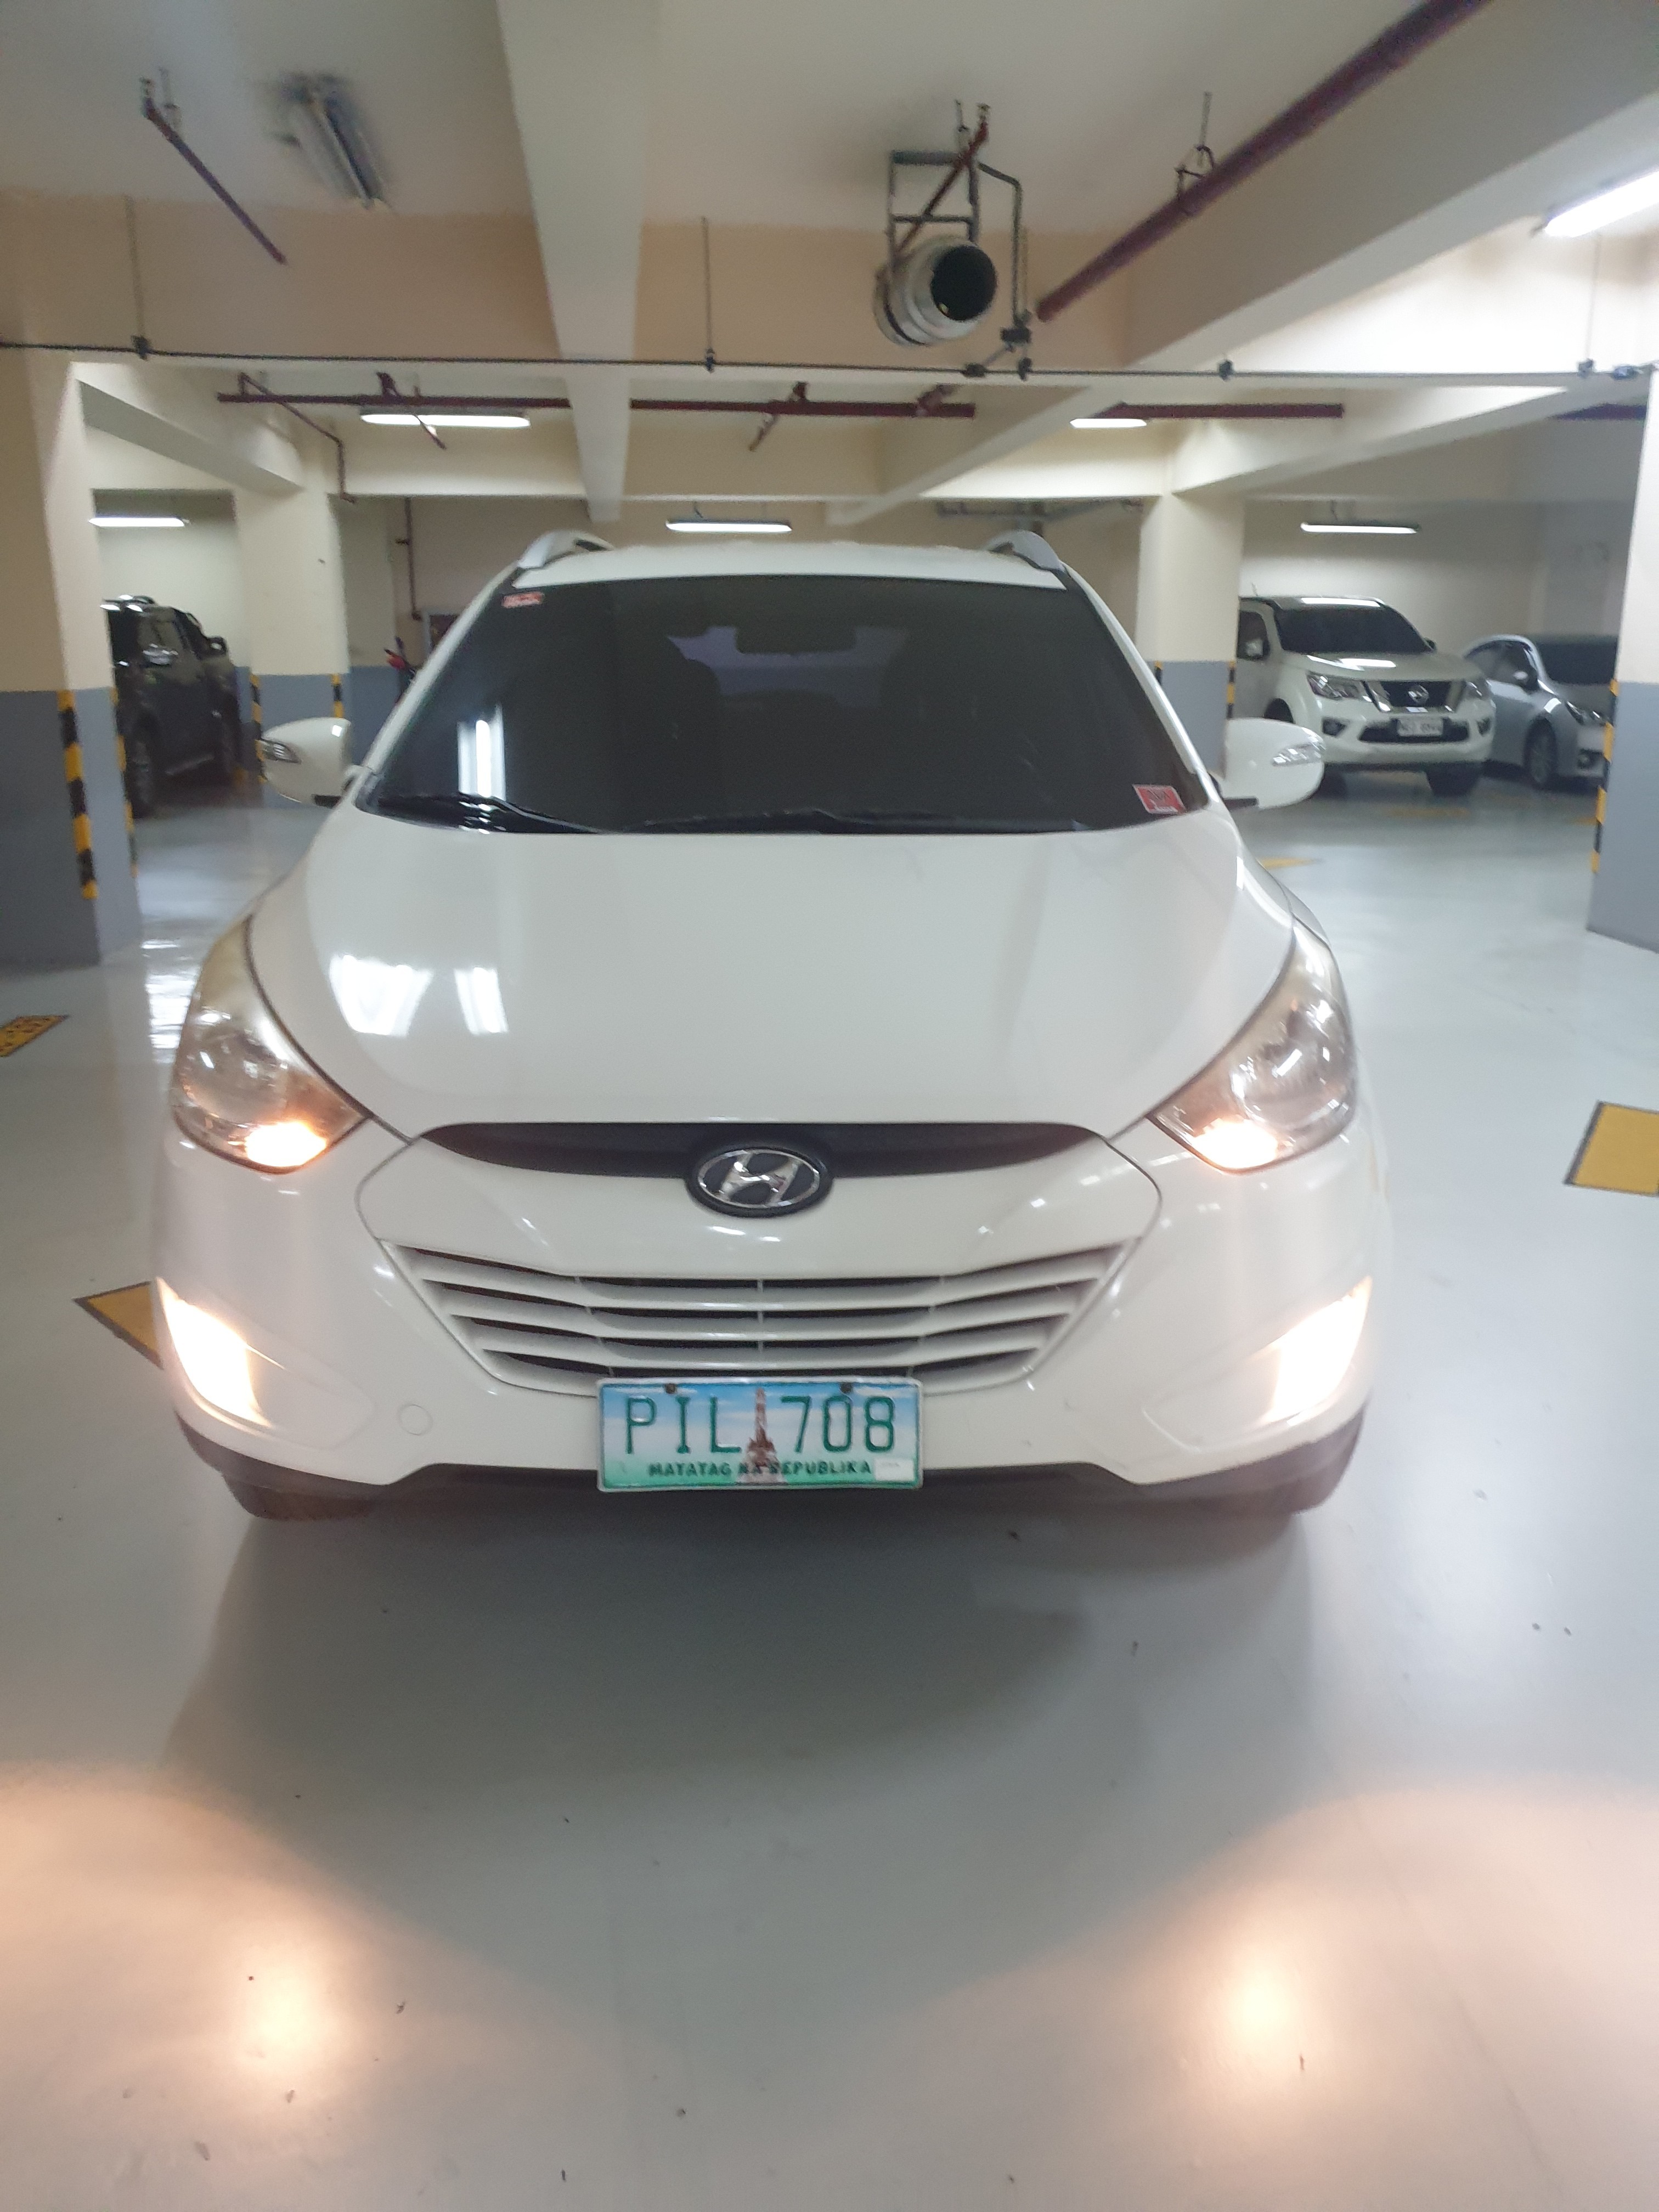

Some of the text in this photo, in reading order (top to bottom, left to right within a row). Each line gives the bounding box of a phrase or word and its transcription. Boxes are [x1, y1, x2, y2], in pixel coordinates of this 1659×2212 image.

[625, 1395, 895, 1454] PIL 708
[649, 1461, 732, 1476] MATATAG
[769, 1460, 872, 1475] REPUBLIKA
